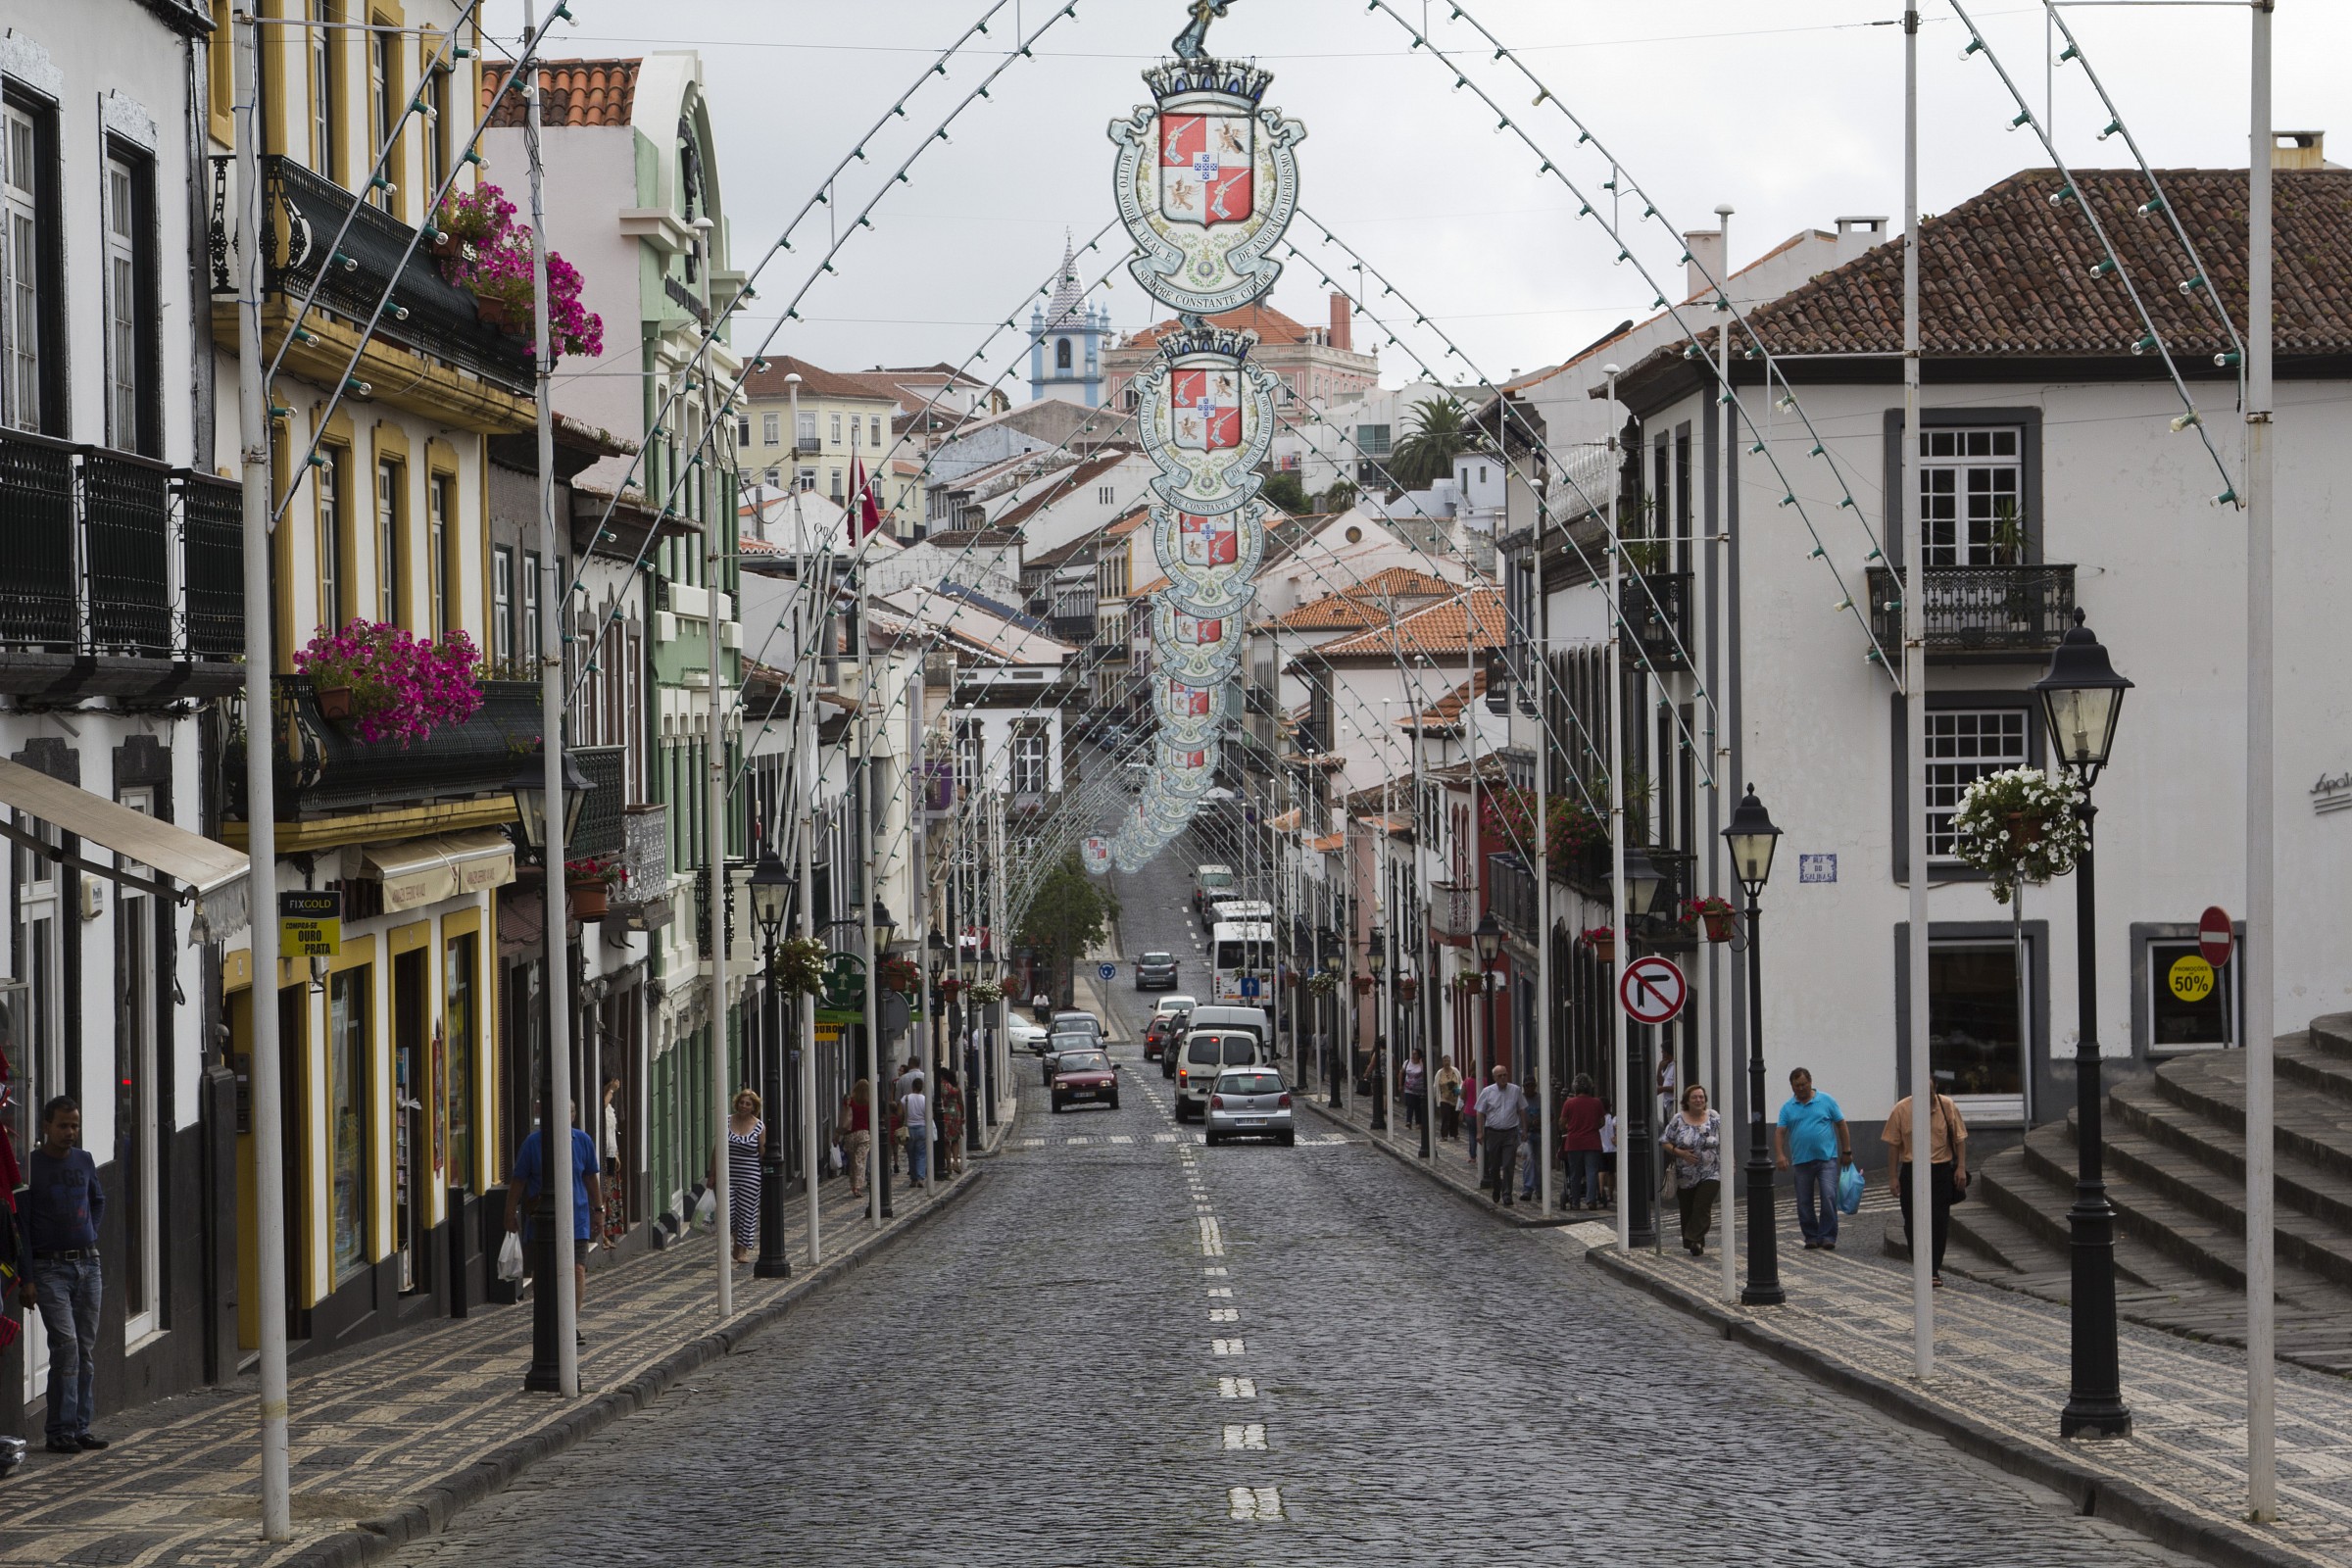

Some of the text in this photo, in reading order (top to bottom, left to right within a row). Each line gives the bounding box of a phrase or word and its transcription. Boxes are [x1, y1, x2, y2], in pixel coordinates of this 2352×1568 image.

[1119, 153, 1133, 188] MUITO
[1138, 231, 1160, 256] LEAL
[1164, 251, 1174, 262] E
[1237, 248, 1253, 262] DE
[1252, 223, 1281, 253] ANGRA
[1276, 207, 1288, 221] DO
[1137, 270, 1273, 308] SEMPRE CONSTANTE CIDADE
[1143, 398, 1152, 424] MUITO
[1156, 455, 1174, 473] LEAL
[1177, 469, 1184, 478] E
[1231, 466, 1243, 477] DE
[1242, 446, 1263, 469] ANGRA
[1258, 436, 1268, 448] DO
[1156, 484, 1184, 507] SEMPRE
[1185, 501, 1232, 512] CONSTANTE
[289, 899, 331, 909] FIXGOLD
[298, 930, 322, 942] OURO
[305, 943, 331, 955] PRATA
[2175, 975, 2209, 992] 50%
